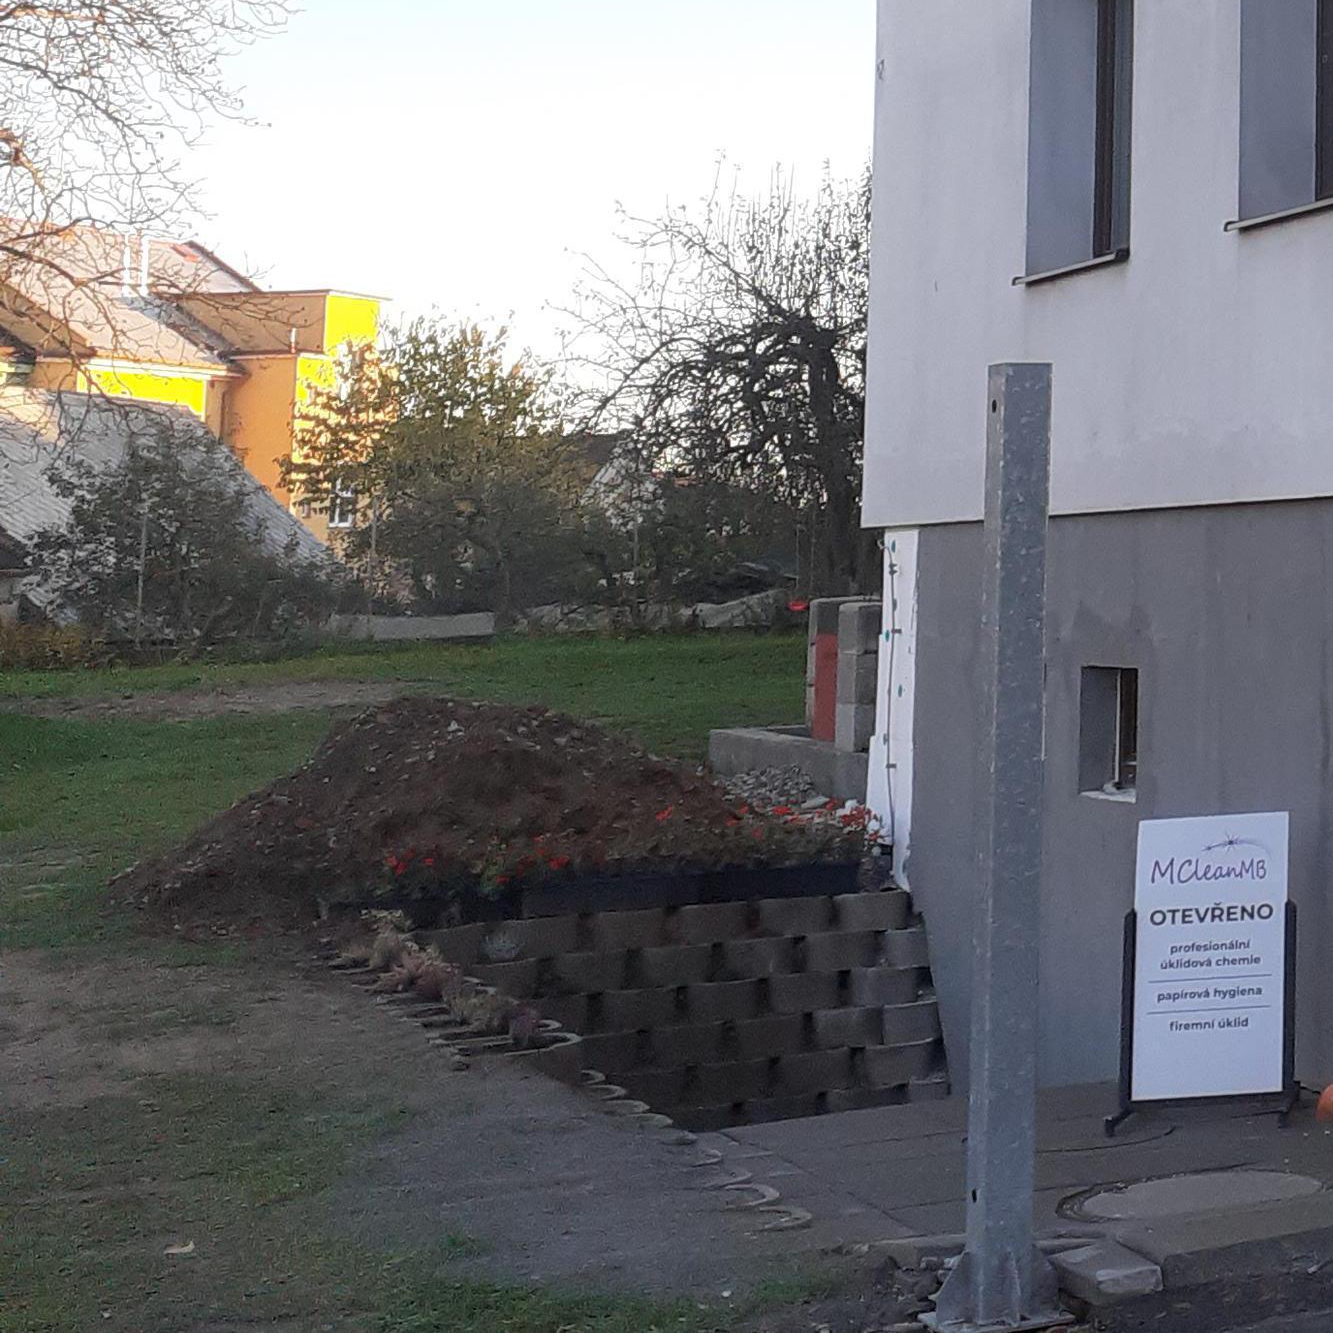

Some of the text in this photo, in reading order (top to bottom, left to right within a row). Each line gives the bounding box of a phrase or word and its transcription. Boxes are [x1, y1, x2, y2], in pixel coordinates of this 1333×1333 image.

[1150, 857, 1267, 885] MCleanMB
[1149, 902, 1274, 927] OTEVŘENO
[1169, 938, 1251, 955] profesionální
[1159, 954, 1261, 970] úklidová chemie
[1157, 985, 1263, 1003] papírová hygiena
[1169, 1016, 1249, 1032] firemní úklid
